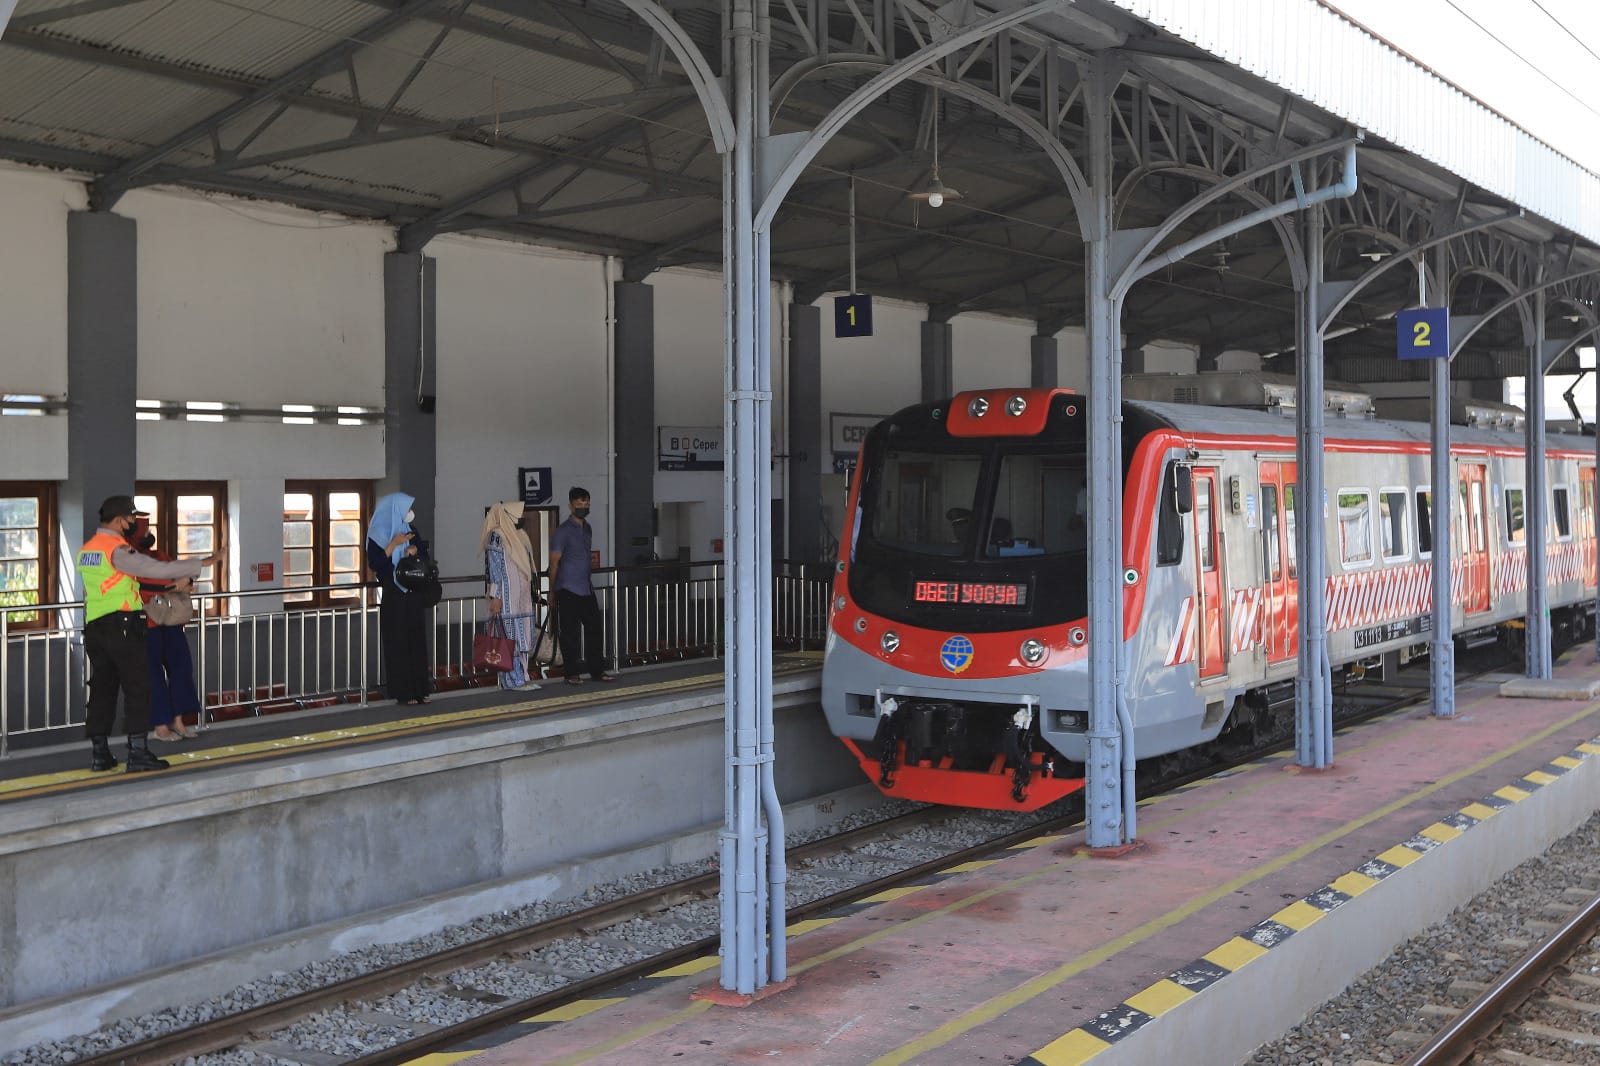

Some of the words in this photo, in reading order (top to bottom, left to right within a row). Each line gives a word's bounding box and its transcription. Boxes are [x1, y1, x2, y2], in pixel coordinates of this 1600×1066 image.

[846, 305, 856, 326] 1
[1414, 321, 1431, 347] 2
[842, 425, 872, 442] CEP
[693, 438, 719, 453] Ceper
[961, 584, 1018, 604] YOGYA
